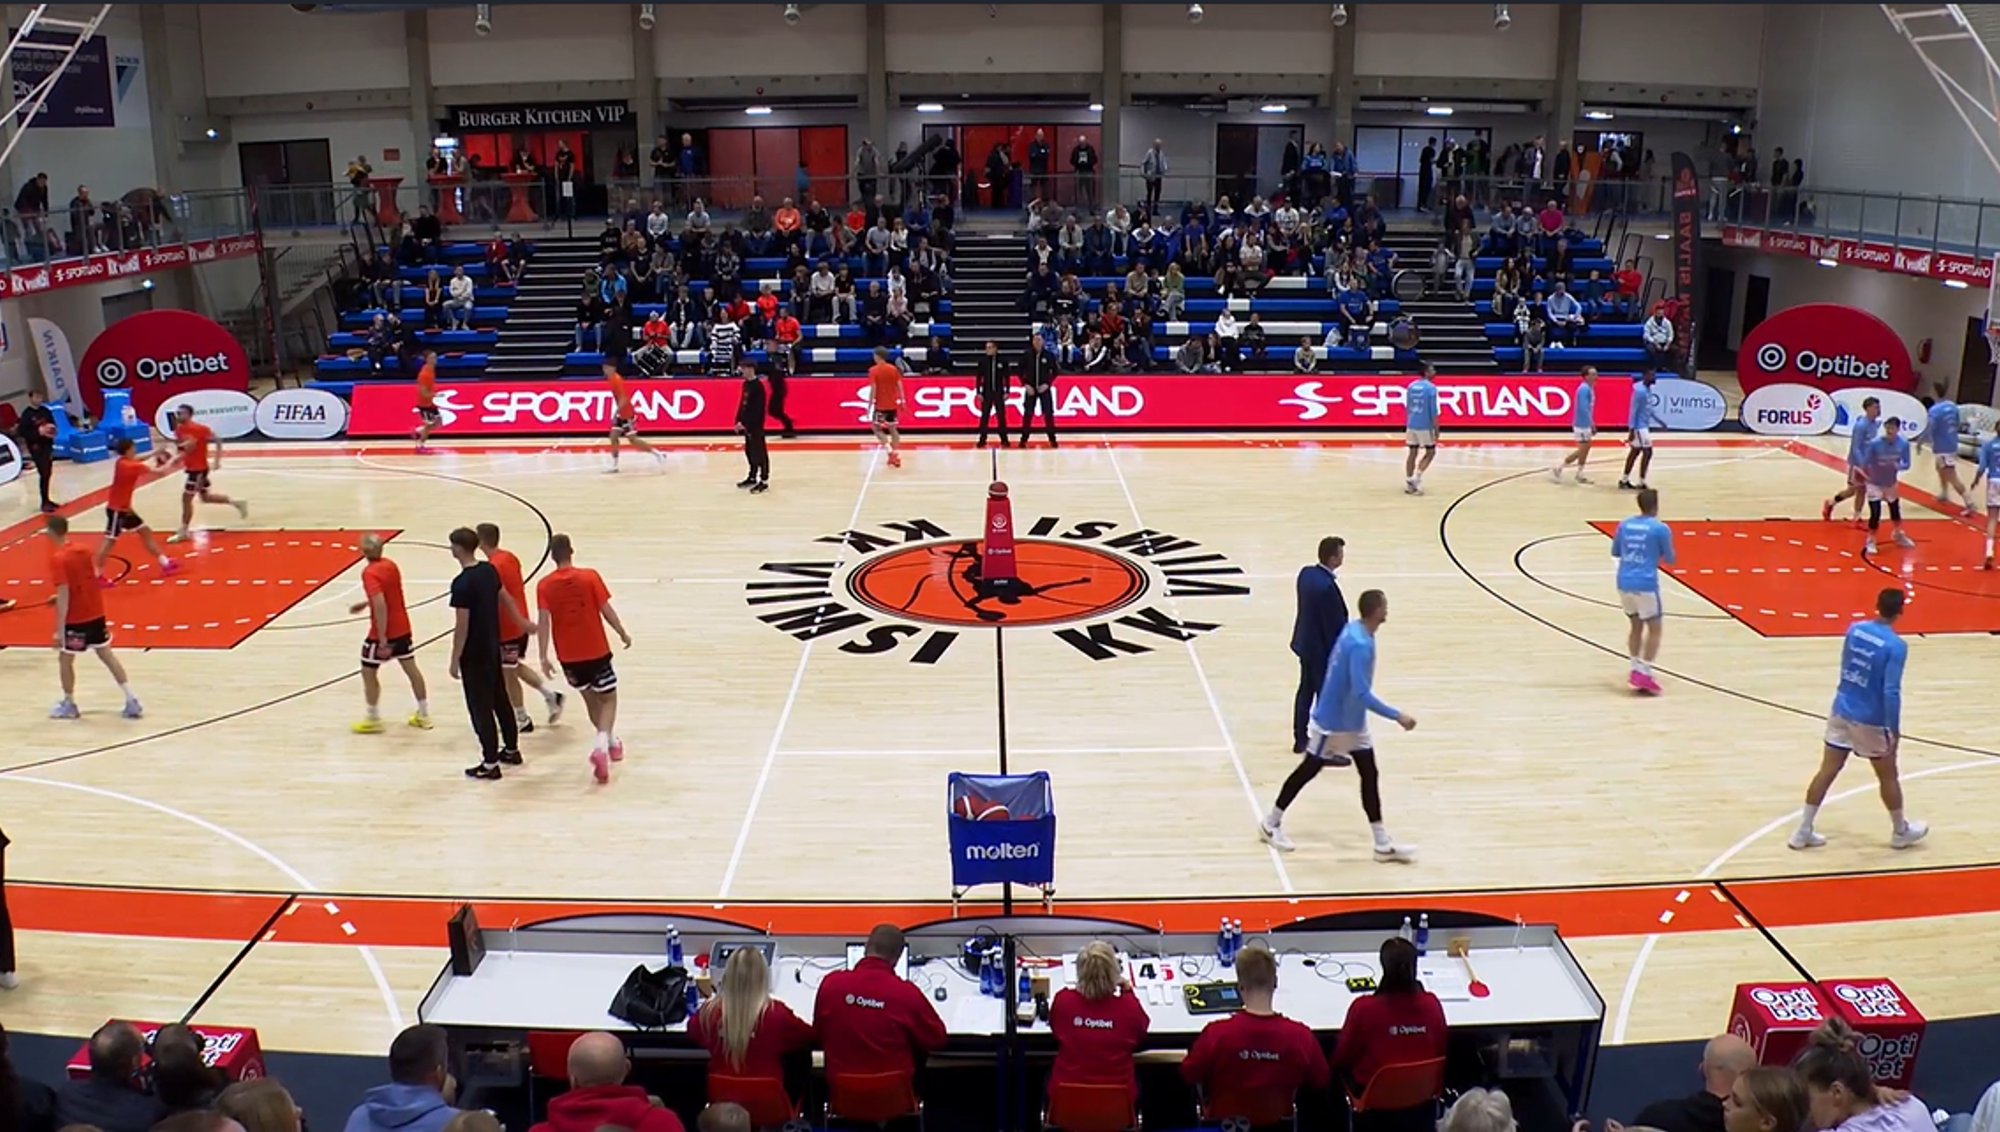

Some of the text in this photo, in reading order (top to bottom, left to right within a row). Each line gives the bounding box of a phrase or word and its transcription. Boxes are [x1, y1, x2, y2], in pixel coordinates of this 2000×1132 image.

[458, 105, 625, 127] BURGER KITCHEN VIP
[136, 352, 229, 382] Optibet
[1796, 350, 1890, 379] Optibet
[1351, 384, 1571, 418] SPRTLAND
[275, 404, 326, 421] FIFAA
[1757, 409, 1813, 425] FORUS
[966, 842, 1039, 860] molten
[1139, 963, 1157, 980] 4
[855, 995, 885, 1010] Optibet
[1751, 987, 1817, 1008] Opti
[1835, 984, 1899, 1006] Opti
[1772, 1003, 1823, 1020] bet
[1856, 1000, 1906, 1016] bet
[1084, 1017, 1113, 1029] Optibet
[1857, 1033, 1918, 1061] Opti
